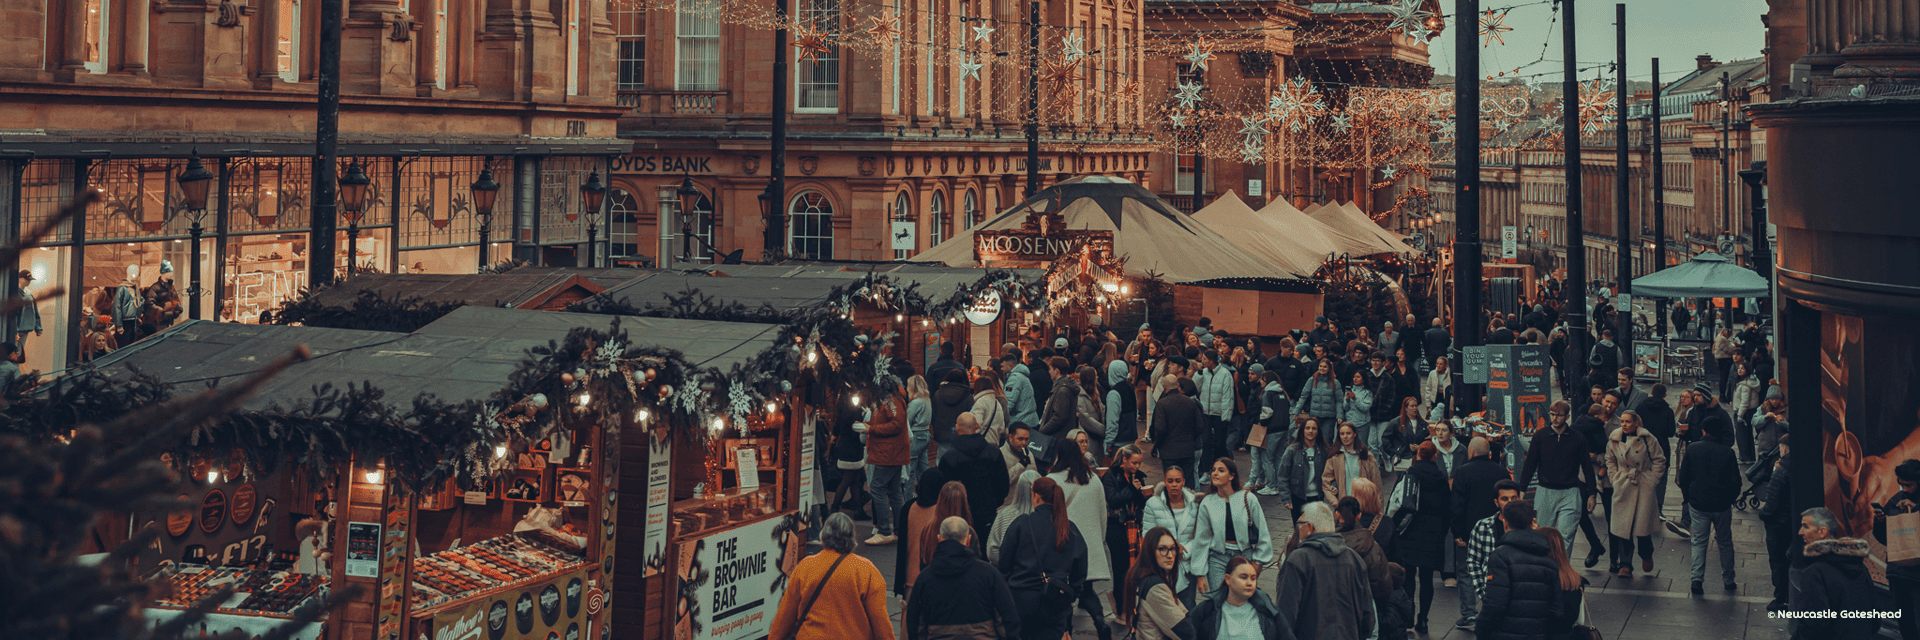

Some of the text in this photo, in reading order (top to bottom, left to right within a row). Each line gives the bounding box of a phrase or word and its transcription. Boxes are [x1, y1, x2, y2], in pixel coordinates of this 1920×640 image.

[567, 120, 587, 136] END.
[610, 156, 712, 172] OYDS BANK
[979, 234, 1076, 256] MOOSENW
[716, 537, 738, 564] THE
[714, 551, 767, 588] BROWNIE
[713, 585, 737, 613] BAR
